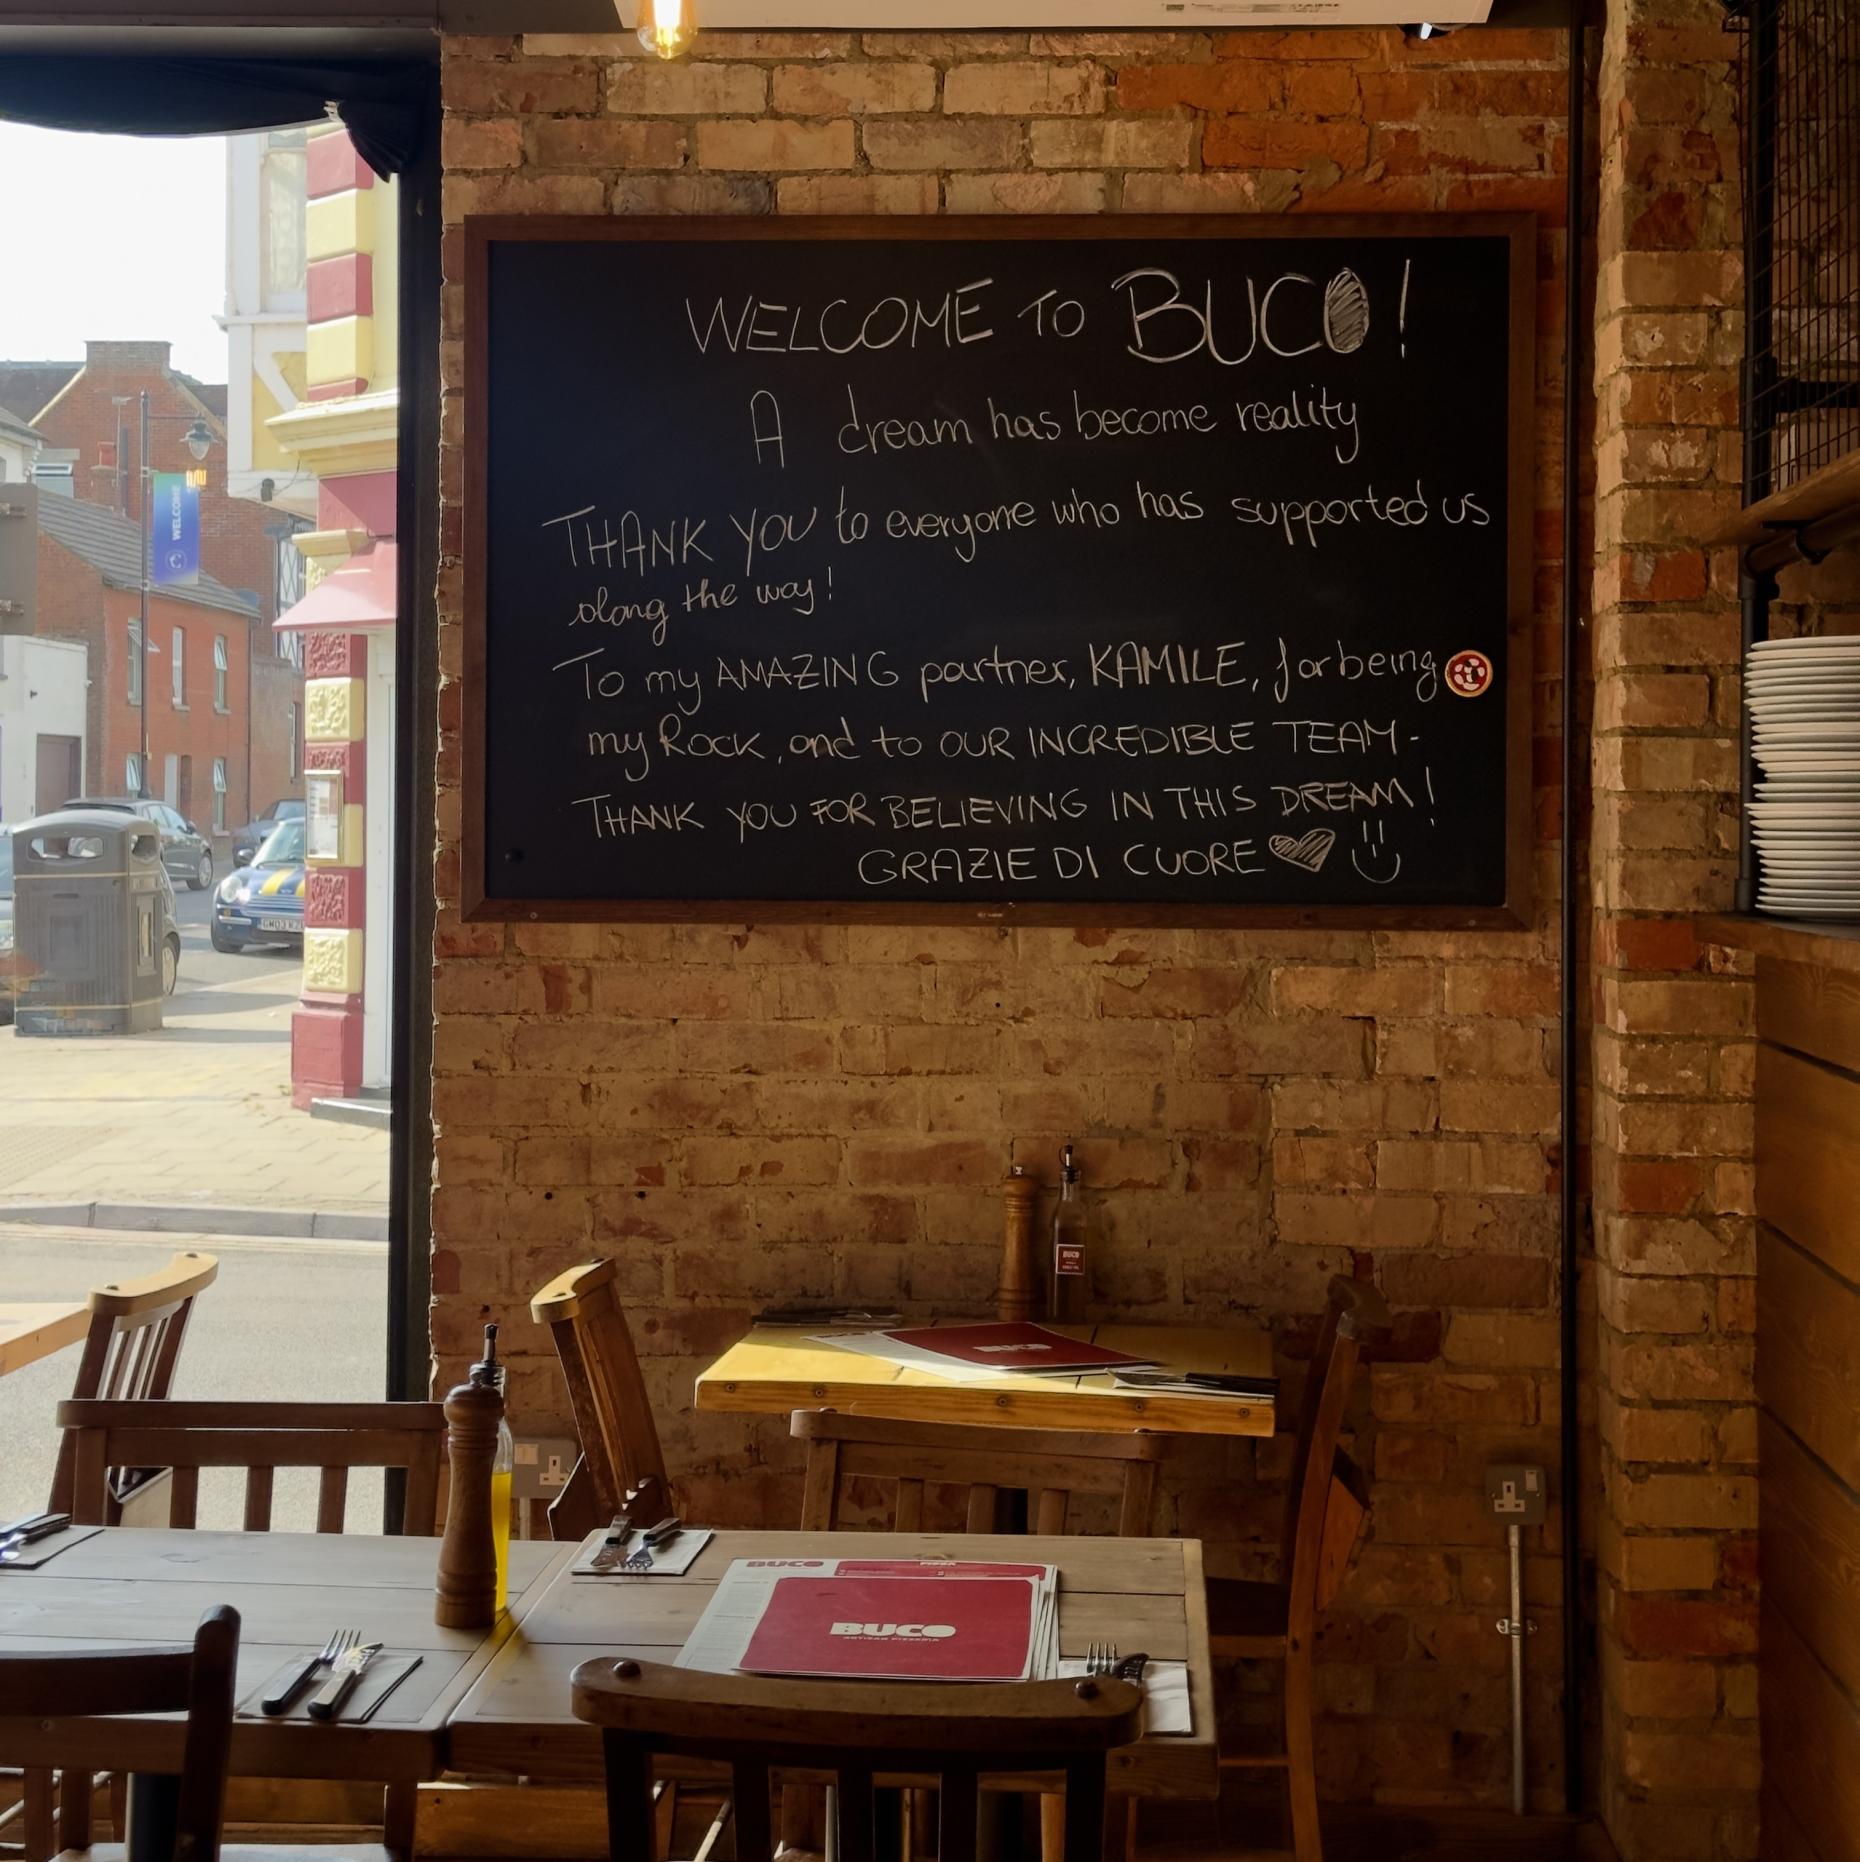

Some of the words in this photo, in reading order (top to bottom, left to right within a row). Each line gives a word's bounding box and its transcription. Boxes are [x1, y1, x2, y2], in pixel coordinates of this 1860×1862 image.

[686, 277, 994, 355] WELCOME
[750, 389, 785, 469] A
[837, 383, 974, 455] dream
[986, 396, 1062, 441] has
[1072, 389, 1218, 441] become
[1235, 383, 1360, 465] reality
[171, 484, 182, 541] WELCOME
[541, 504, 714, 577] THANK
[834, 485, 869, 545] to
[885, 501, 1037, 564] everyone
[1051, 487, 1120, 529] who
[1136, 480, 1205, 521] has
[1230, 478, 1429, 549] supported
[1442, 492, 1490, 526] us
[568, 586, 670, 647] along
[681, 578, 738, 613] the
[644, 668, 702, 716] my
[716, 650, 900, 692] AMAZING
[1273, 636, 1332, 704] for
[1336, 639, 1438, 703] being
[588, 731, 650, 782] my
[871, 725, 923, 758] to
[939, 726, 1016, 761] OUR
[1028, 720, 1255, 759] INCREDIBLE
[571, 793, 705, 839] THANK
[725, 801, 797, 844] YOU
[809, 791, 876, 827] FOR
[880, 787, 1088, 830] BELIEVING
[1110, 789, 1155, 822] IN
[1162, 784, 1257, 820] THIS
[857, 847, 1038, 885] GRAZIE
[1052, 844, 1100, 879] DI
[1123, 838, 1266, 877] CUORE
[829, 1622, 956, 1638] BUCO
